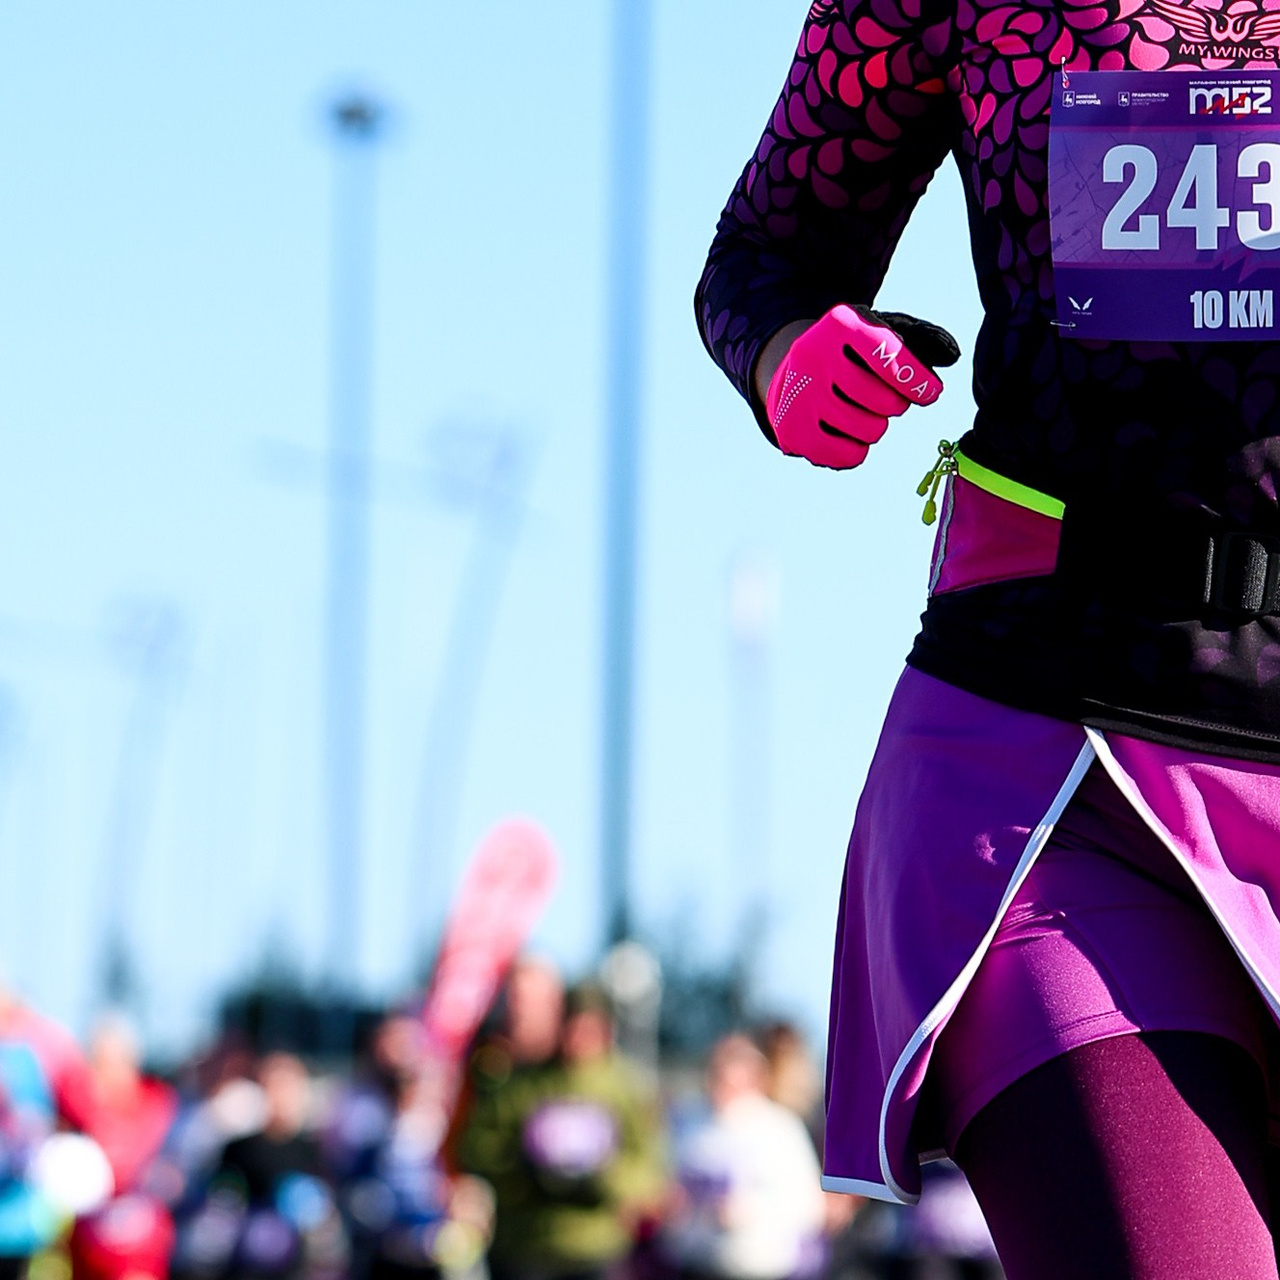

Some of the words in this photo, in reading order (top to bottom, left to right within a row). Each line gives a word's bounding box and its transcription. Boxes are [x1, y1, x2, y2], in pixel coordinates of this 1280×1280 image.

[1179, 43, 1207, 56] MY
[1213, 46, 1275, 59] WINGS
[1190, 290, 1223, 329] 10
